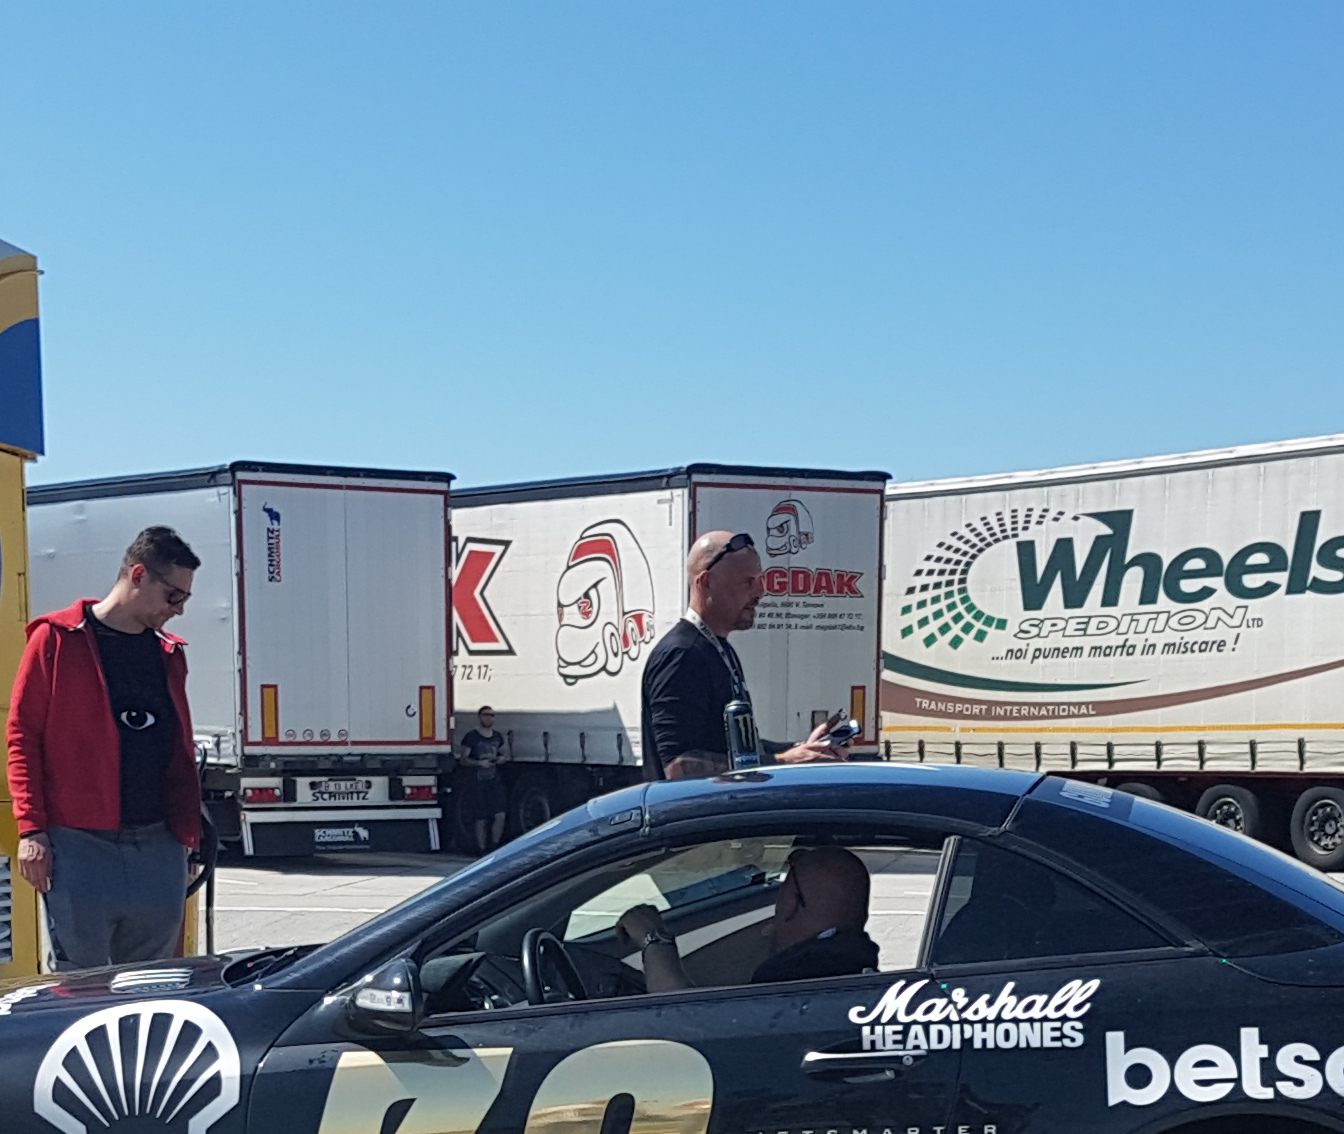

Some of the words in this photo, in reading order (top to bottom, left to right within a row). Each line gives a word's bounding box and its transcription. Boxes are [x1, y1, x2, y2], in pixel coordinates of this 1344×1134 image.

[267, 527, 275, 582] SCHMITZ
[761, 566, 864, 598] GDAK
[1013, 606, 1249, 639] SPEDITION
[1246, 617, 1264, 629] LTD
[991, 643, 1027, 661] ...noi
[1031, 645, 1084, 664] punem
[1088, 638, 1136, 658] marfa
[1141, 638, 1156, 656] in
[1161, 636, 1226, 655] miscare
[461, 665, 472, 680] 72
[477, 665, 492, 682] 17;
[915, 698, 988, 716] TRANSPORT
[991, 704, 1097, 717] INTERNATIONAL
[312, 791, 369, 801] SCHMITZ
[848, 978, 1101, 1024] Marshall
[861, 1020, 1084, 1051] HEADPHONES
